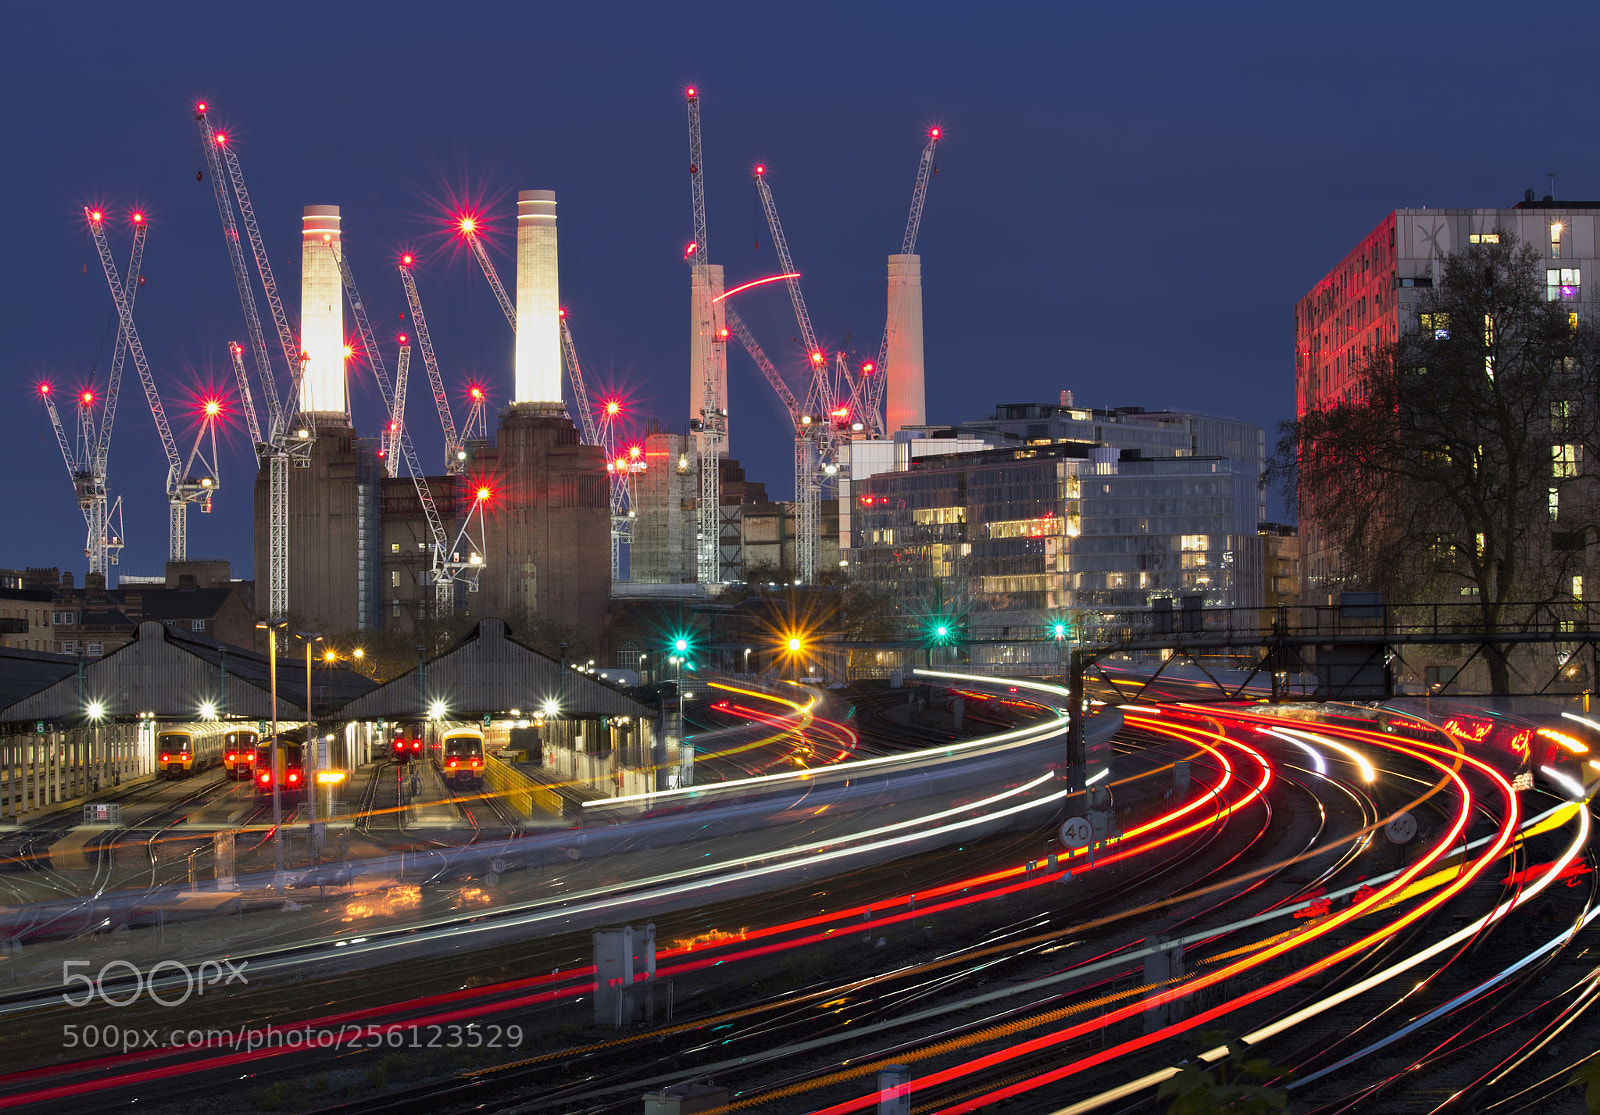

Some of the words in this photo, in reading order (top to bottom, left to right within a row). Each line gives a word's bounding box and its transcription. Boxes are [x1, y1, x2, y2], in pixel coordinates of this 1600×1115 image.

[143, 718, 150, 729] 5
[377, 719, 384, 730] 3
[484, 716, 490, 725] 2
[37, 722, 44, 733] 6
[259, 723, 265, 732] 4
[1065, 824, 1089, 840] 40
[1391, 819, 1413, 836] 40
